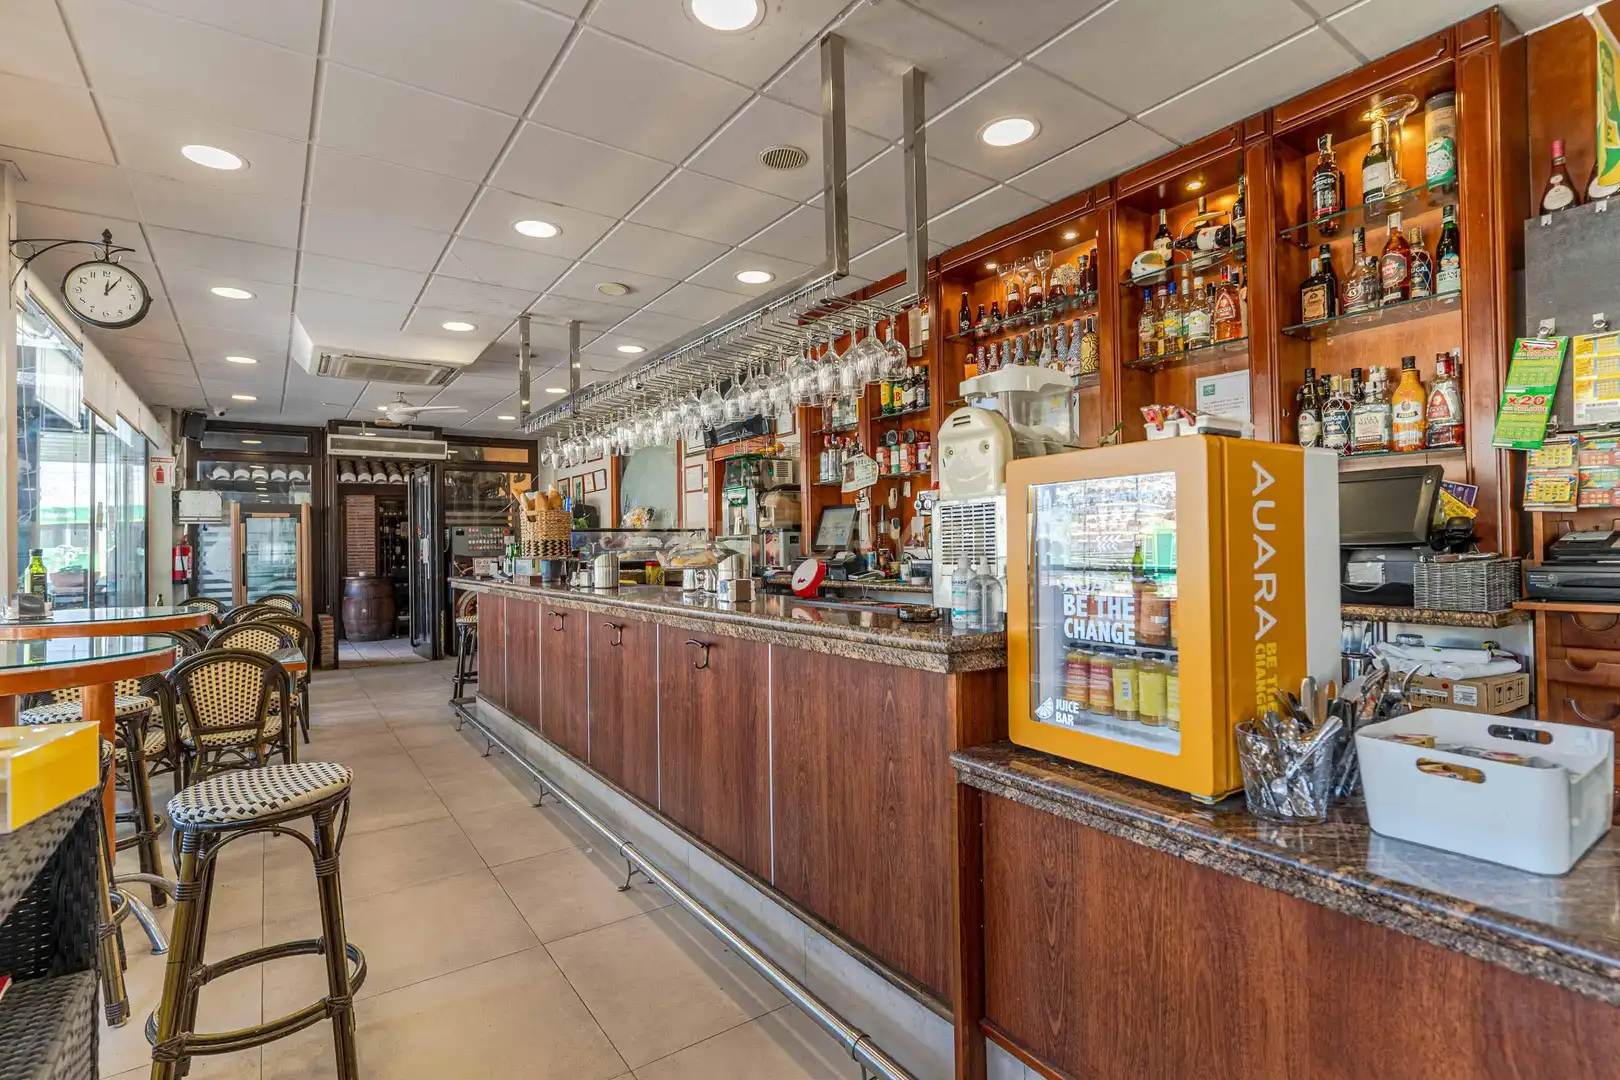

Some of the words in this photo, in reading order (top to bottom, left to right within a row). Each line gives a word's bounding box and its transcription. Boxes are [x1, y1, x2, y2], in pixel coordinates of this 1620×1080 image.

[103, 270, 111, 278] 12
[90, 305, 95, 313] 7
[1507, 395, 1546, 406] x20
[1251, 460, 1278, 641] AUARA
[1063, 594, 1088, 617] BE
[1094, 595, 1136, 621] THE
[1063, 617, 1136, 645] CHANGE
[1265, 642, 1278, 669] BE
[1255, 643, 1268, 718] CHANGE
[1055, 698, 1080, 714] JUICE
[1055, 711, 1075, 727] BAR
